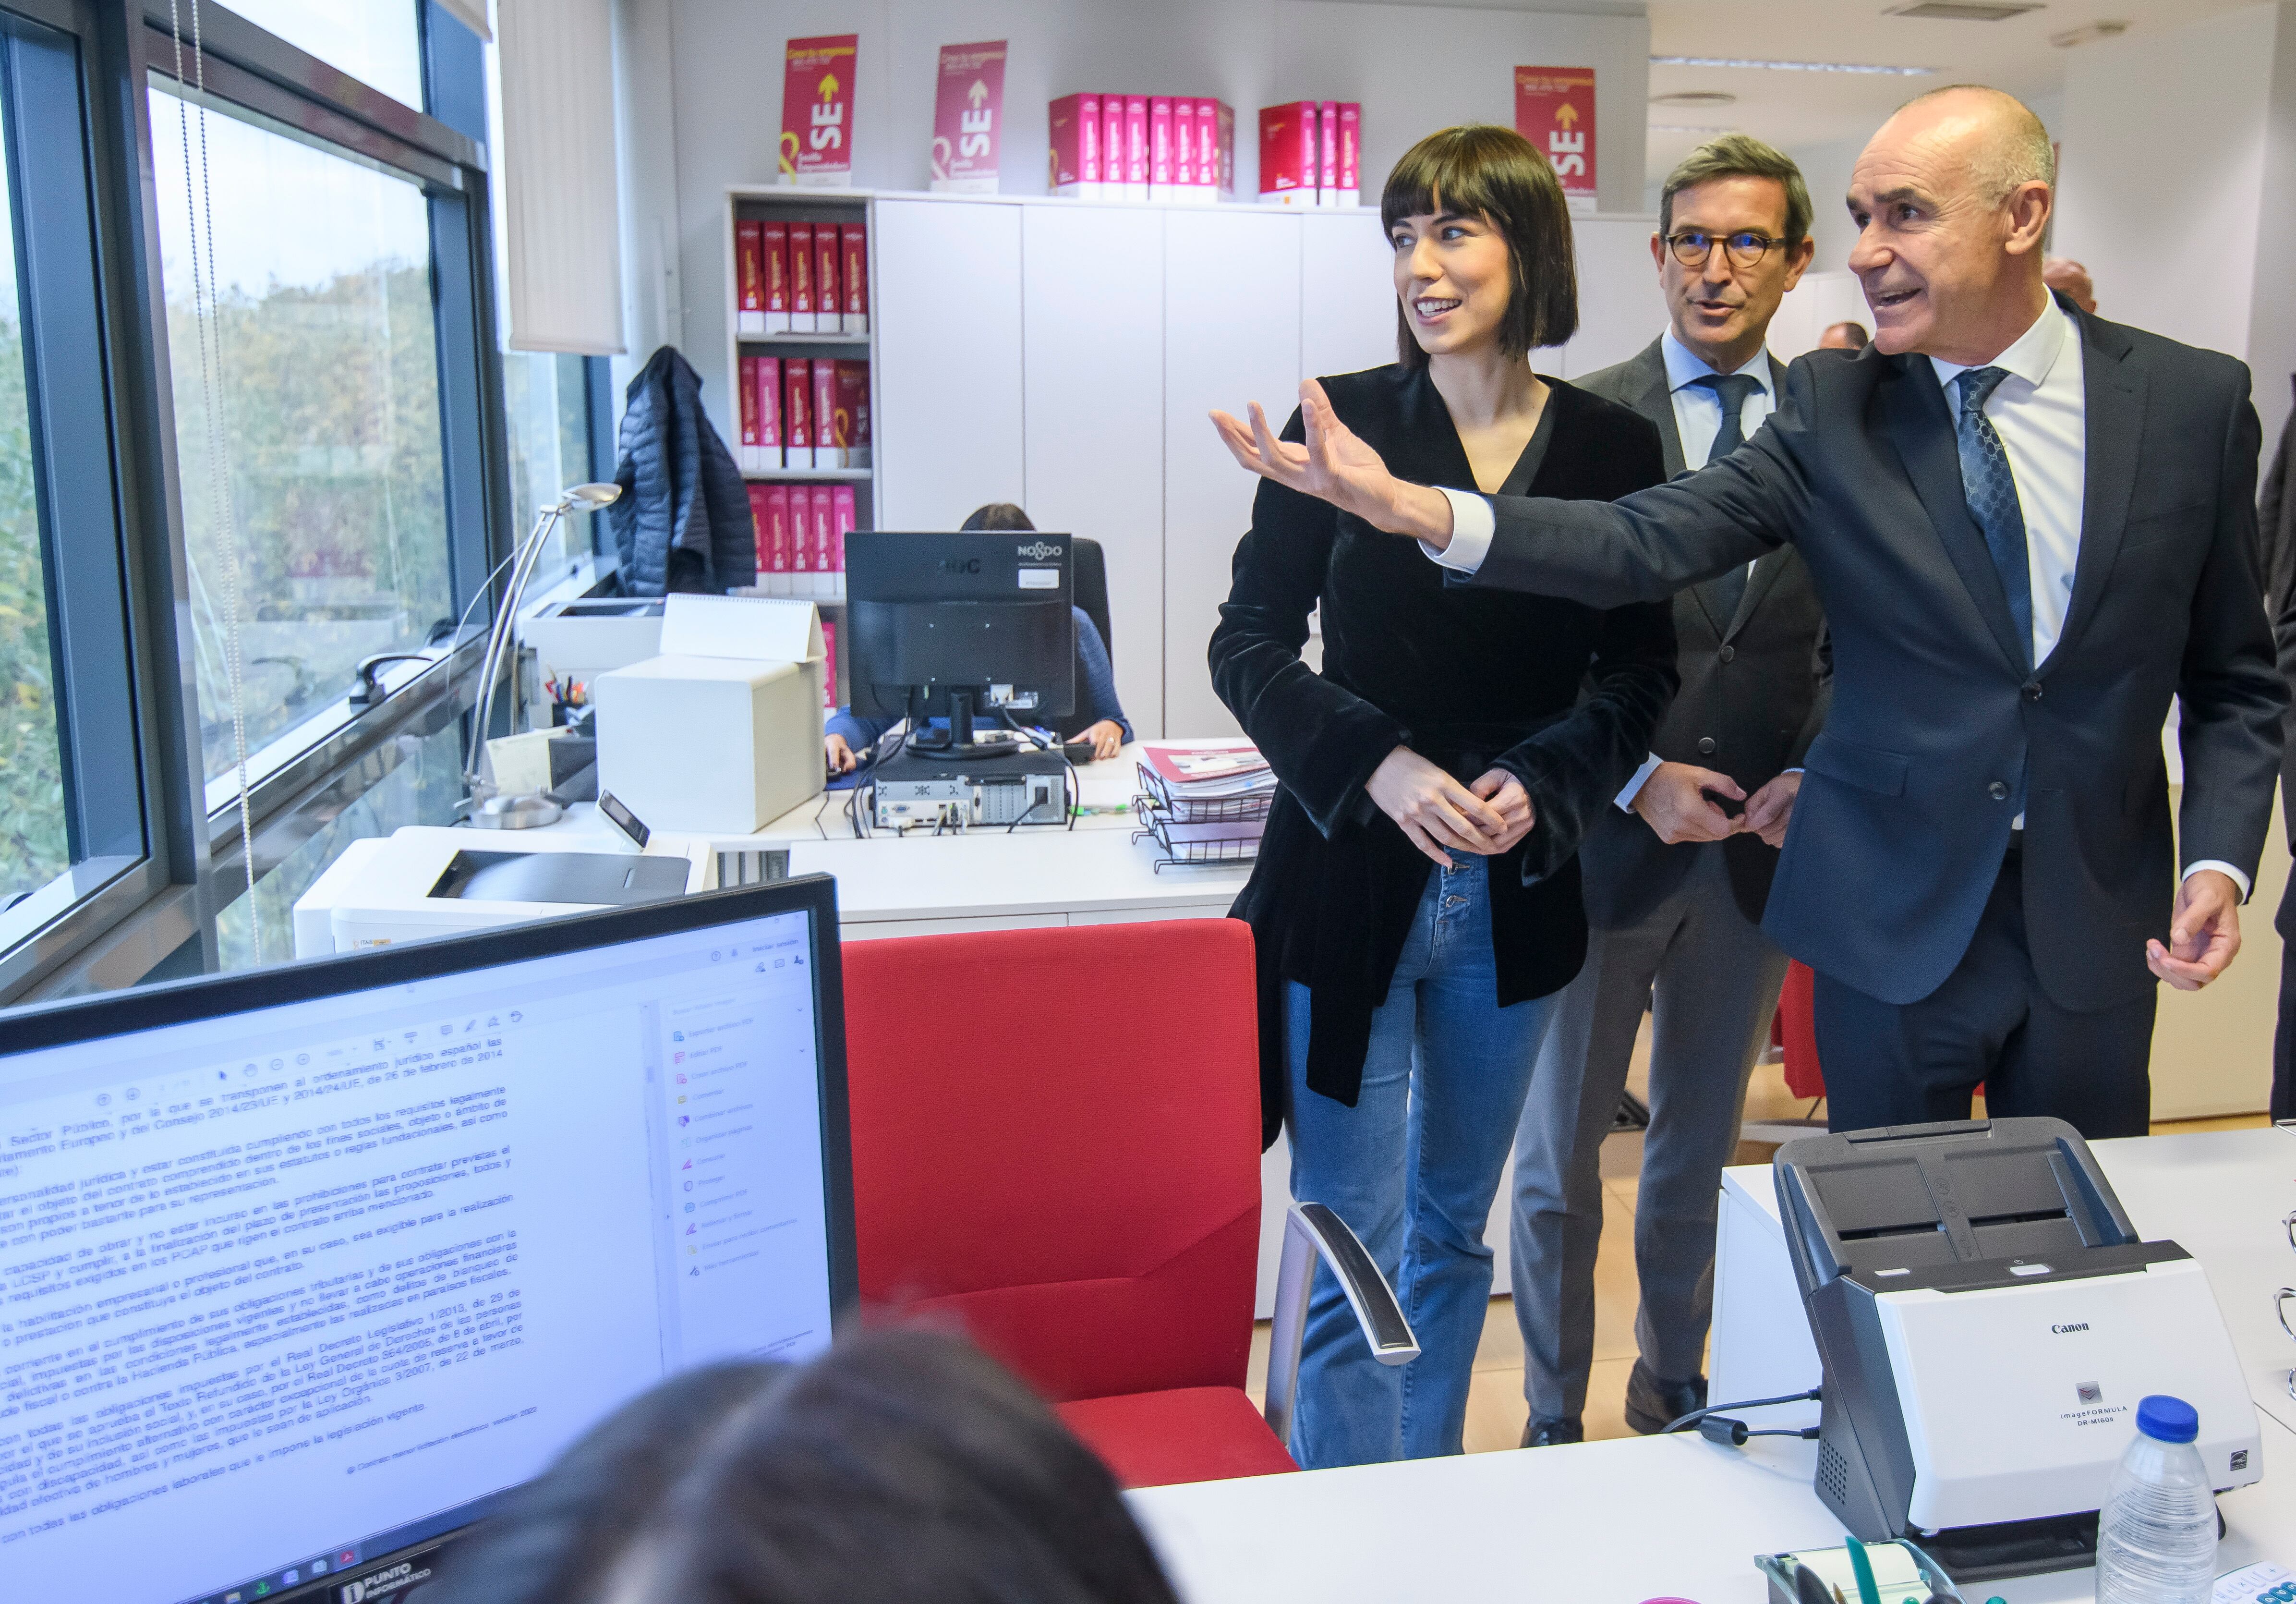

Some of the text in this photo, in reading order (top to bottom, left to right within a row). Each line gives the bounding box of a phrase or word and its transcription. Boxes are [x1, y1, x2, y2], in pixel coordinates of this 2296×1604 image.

[810, 102, 843, 150] SE
[960, 109, 992, 158] SE
[1549, 131, 1584, 176] SE
[60, 1060, 457, 1150] Europeo Consejo 2014/23/UE febrero
[221, 1081, 287, 1103] transponen
[313, 1061, 388, 1084] ordenamiento
[178, 1085, 506, 1166] constituida cumpliendo requisitos legalmente
[28, 1140, 377, 1230] propios establecido estatutos reglas
[38, 1148, 282, 1211] objeto contrato comprendido dentro
[245, 1216, 276, 1234] plazo
[474, 1161, 501, 1176] todos
[3, 1149, 497, 1276] capacidad prohibiciones contratar previstas
[11, 1203, 167, 1247] con poder bastante para
[8, 1207, 364, 1304] requisitos exigidos contrato arriba
[96, 1281, 169, 1310] empresarial
[184, 1261, 250, 1289] profesional
[32, 1241, 517, 1383] impuestas disposiciones operaciones financieras
[86, 1313, 110, 1329] que
[114, 1295, 176, 1319] constituya
[193, 1281, 230, 1299] objeto
[104, 1239, 482, 1349] cumplimiento obligaciones tributarias obligaciones
[7, 1259, 499, 1404] delictivas condiciones legalmente blanqueo
[132, 1359, 189, 1383] Hacienda
[244, 1320, 326, 1351] especialmente
[349, 1298, 403, 1321] realizadas
[2052, 1323, 2089, 1334] Canon
[89, 1413, 140, 1436] aprueba
[386, 1325, 436, 1348] Derechos
[476, 1300, 521, 1324] personas
[95, 1316, 423, 1420] obligaciones impuestas Decreto Legislativo
[271, 1382, 289, 1397] por
[307, 1367, 333, 1384] Real
[337, 1355, 378, 1375] Decreto
[520, 1406, 537, 1417] 2022
[9, 1489, 28, 1503] con
[155, 1440, 186, 1458] como
[31, 1419, 294, 1509] efectiva hombres que sean
[268, 1439, 310, 1460] impone
[364, 1563, 411, 1588] PUNTO
